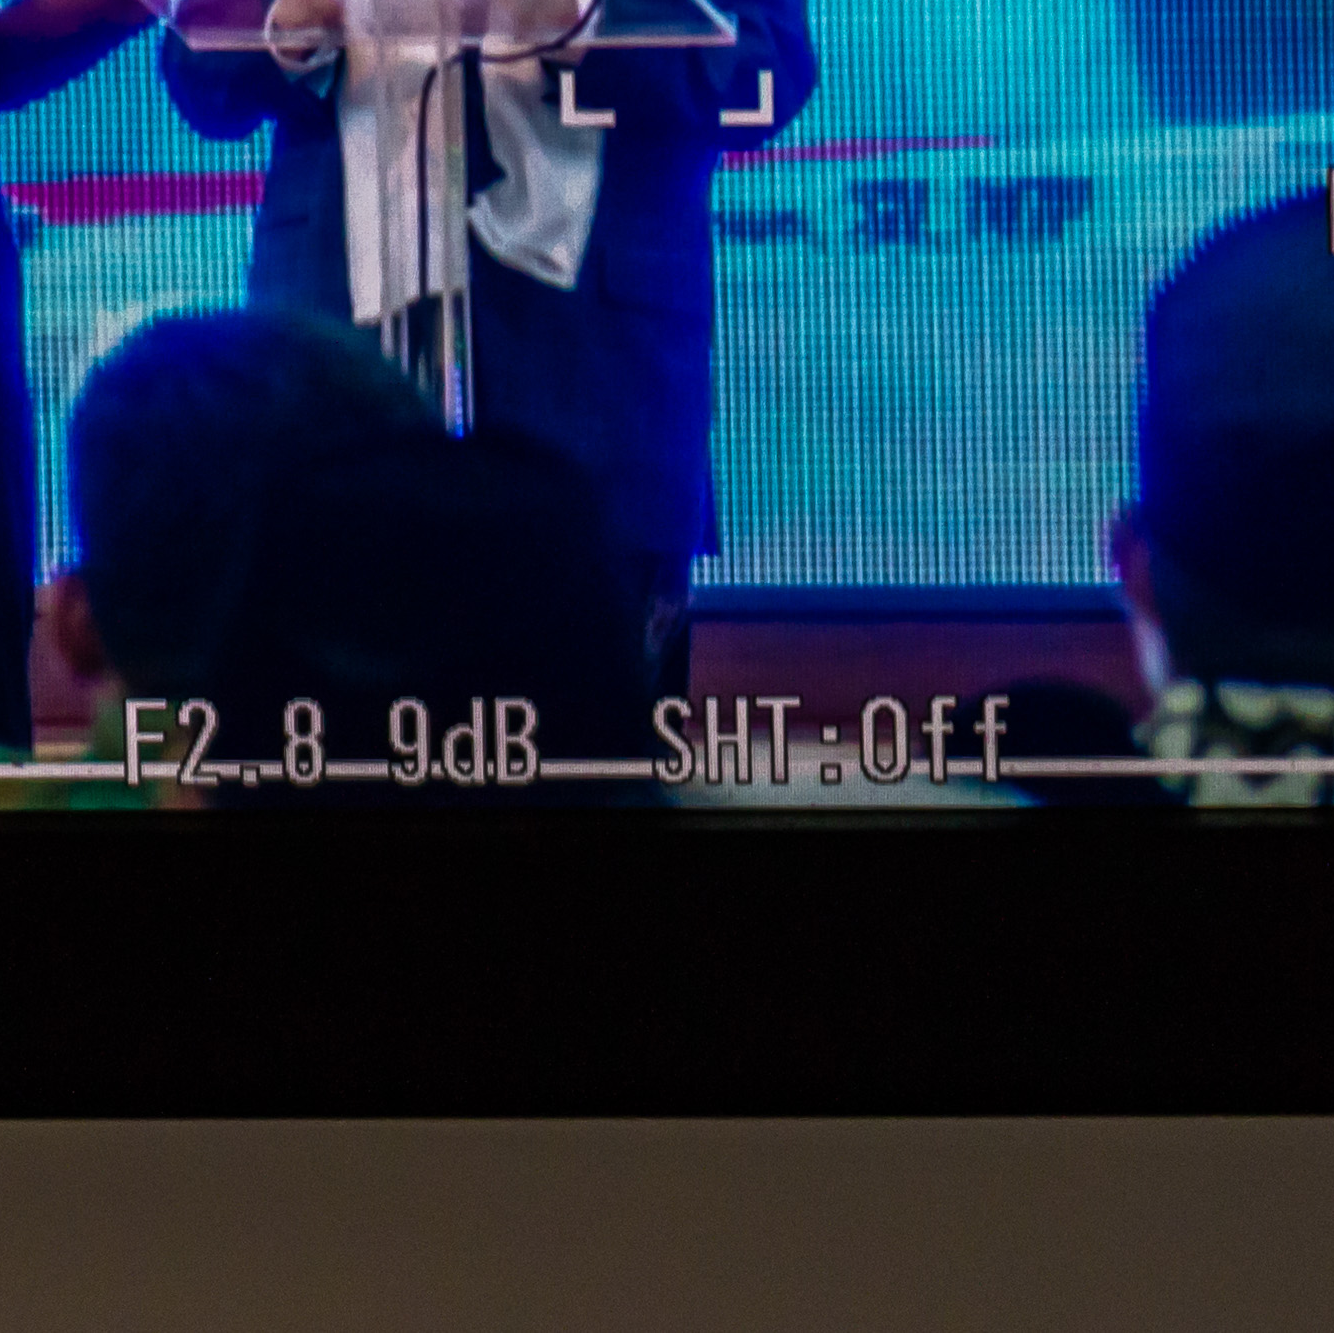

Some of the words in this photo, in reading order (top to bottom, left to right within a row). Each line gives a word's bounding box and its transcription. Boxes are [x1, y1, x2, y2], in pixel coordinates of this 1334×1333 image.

[123, 697, 327, 787] F2.8
[389, 697, 541, 785] 9dB
[652, 696, 1012, 784] SHT:Off
